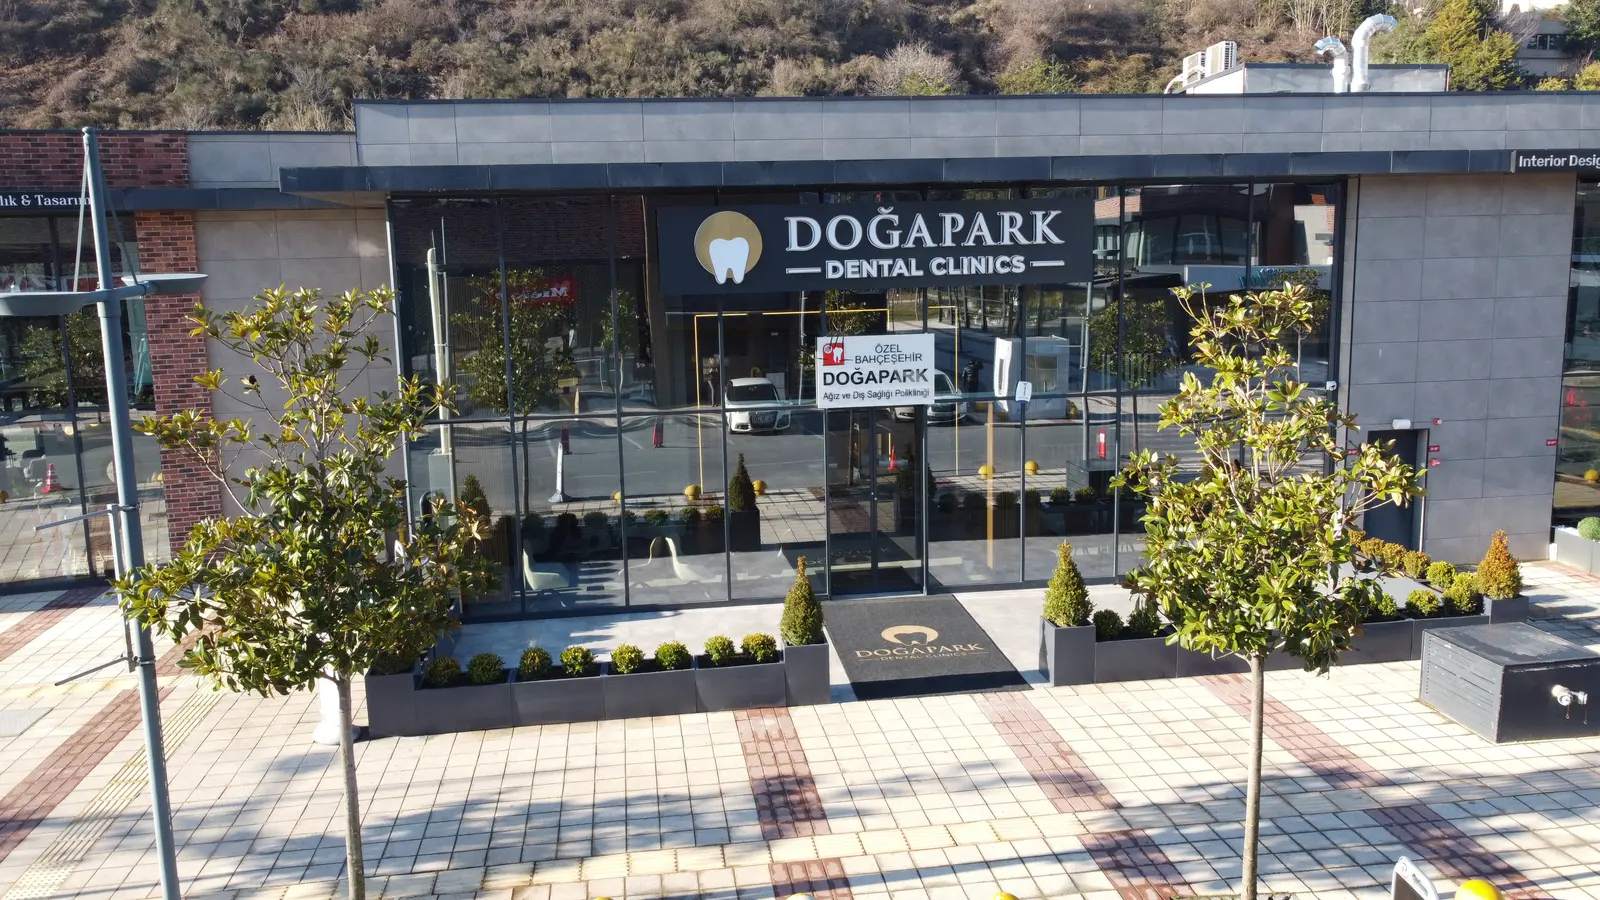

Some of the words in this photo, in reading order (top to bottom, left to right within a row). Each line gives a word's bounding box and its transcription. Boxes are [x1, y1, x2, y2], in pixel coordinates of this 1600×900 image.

[1519, 155, 1567, 167] Interior
[21, 194, 31, 206] &
[784, 206, 1065, 251] DOĞAPARK
[825, 258, 923, 279] DENTAL
[929, 255, 1025, 276] CLINICS
[875, 343, 902, 353] ÖZEL
[855, 353, 922, 365] BAHÇEŞEHİR
[823, 367, 928, 386] DOĞAPARK
[823, 392, 840, 402] Ağız
[867, 390, 892, 400] Sağlığı
